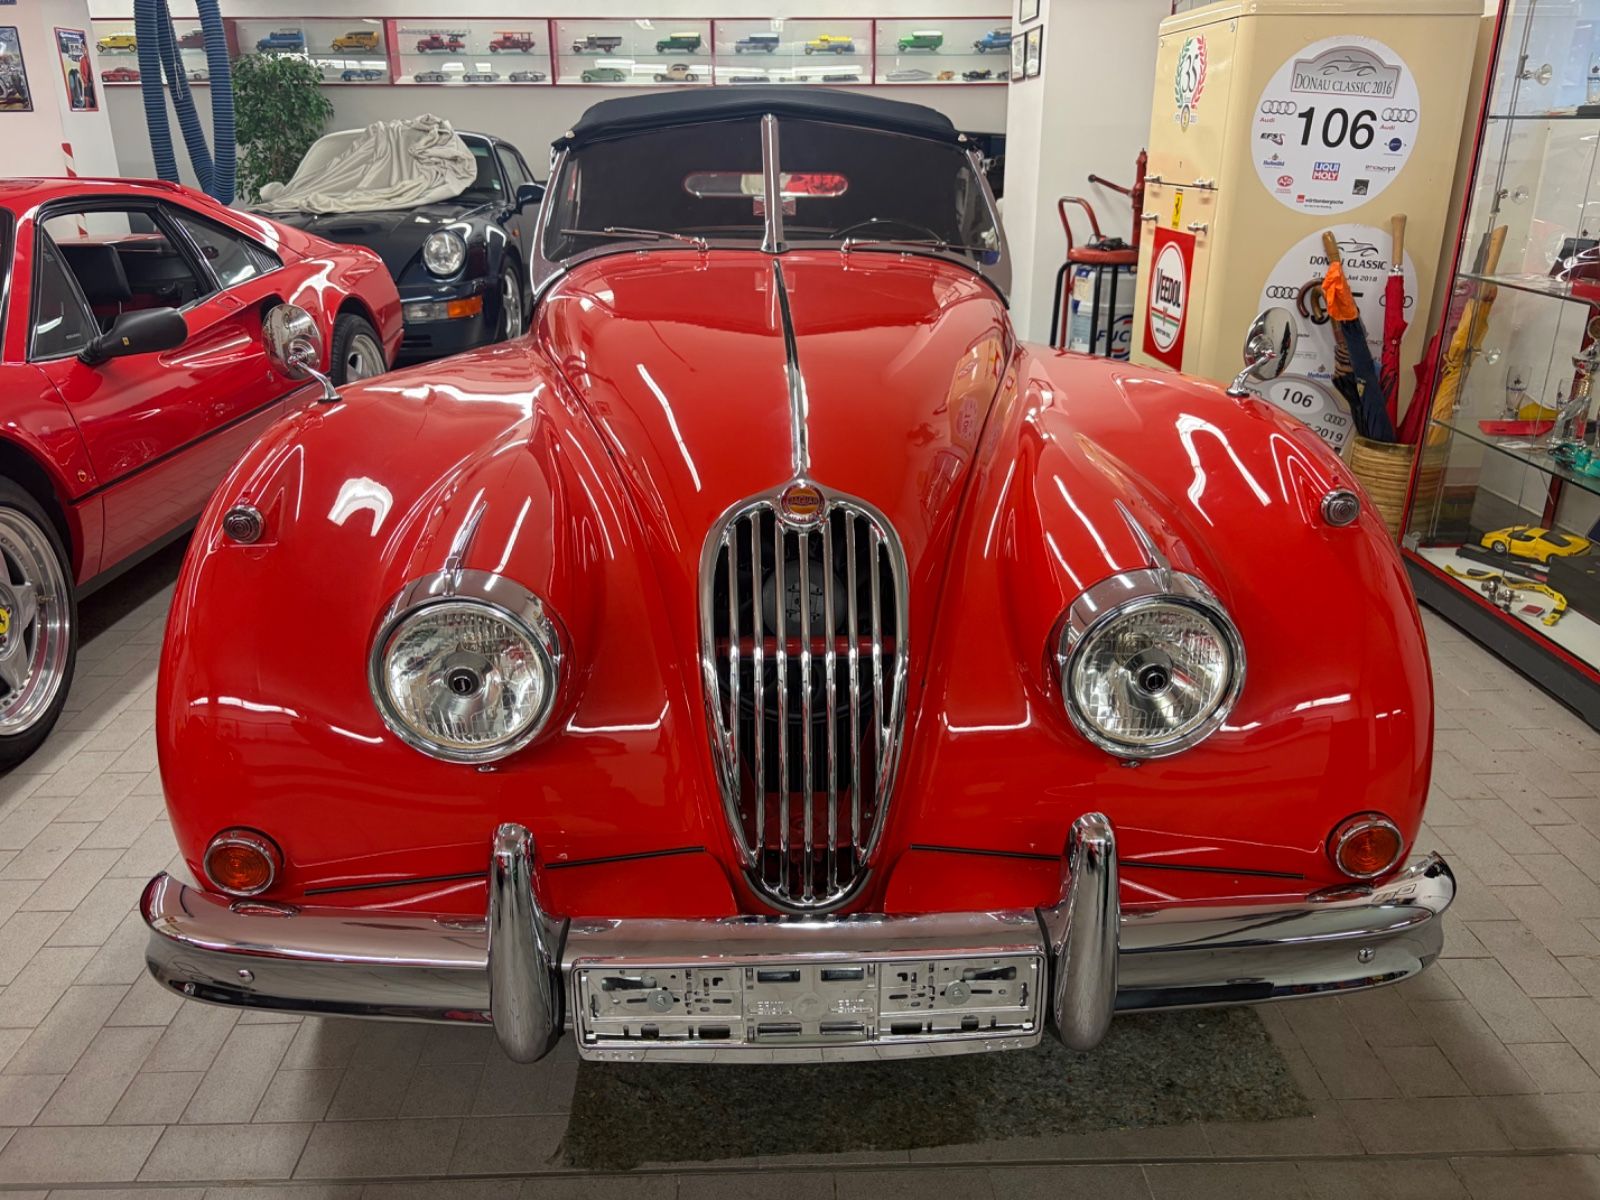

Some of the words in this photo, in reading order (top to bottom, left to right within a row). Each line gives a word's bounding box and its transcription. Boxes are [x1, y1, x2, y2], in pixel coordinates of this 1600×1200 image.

[1294, 74, 1331, 91] DONAU
[1332, 80, 1371, 94] CLASSIC
[1371, 80, 1393, 95] 2016
[1298, 107, 1377, 149] 106
[1312, 171, 1338, 180] MOLY
[1315, 162, 1340, 171] LIQUI
[1347, 258, 1387, 271] CLASSIC
[1155, 268, 1181, 308] VEEDOL
[1283, 388, 1314, 408] 106
